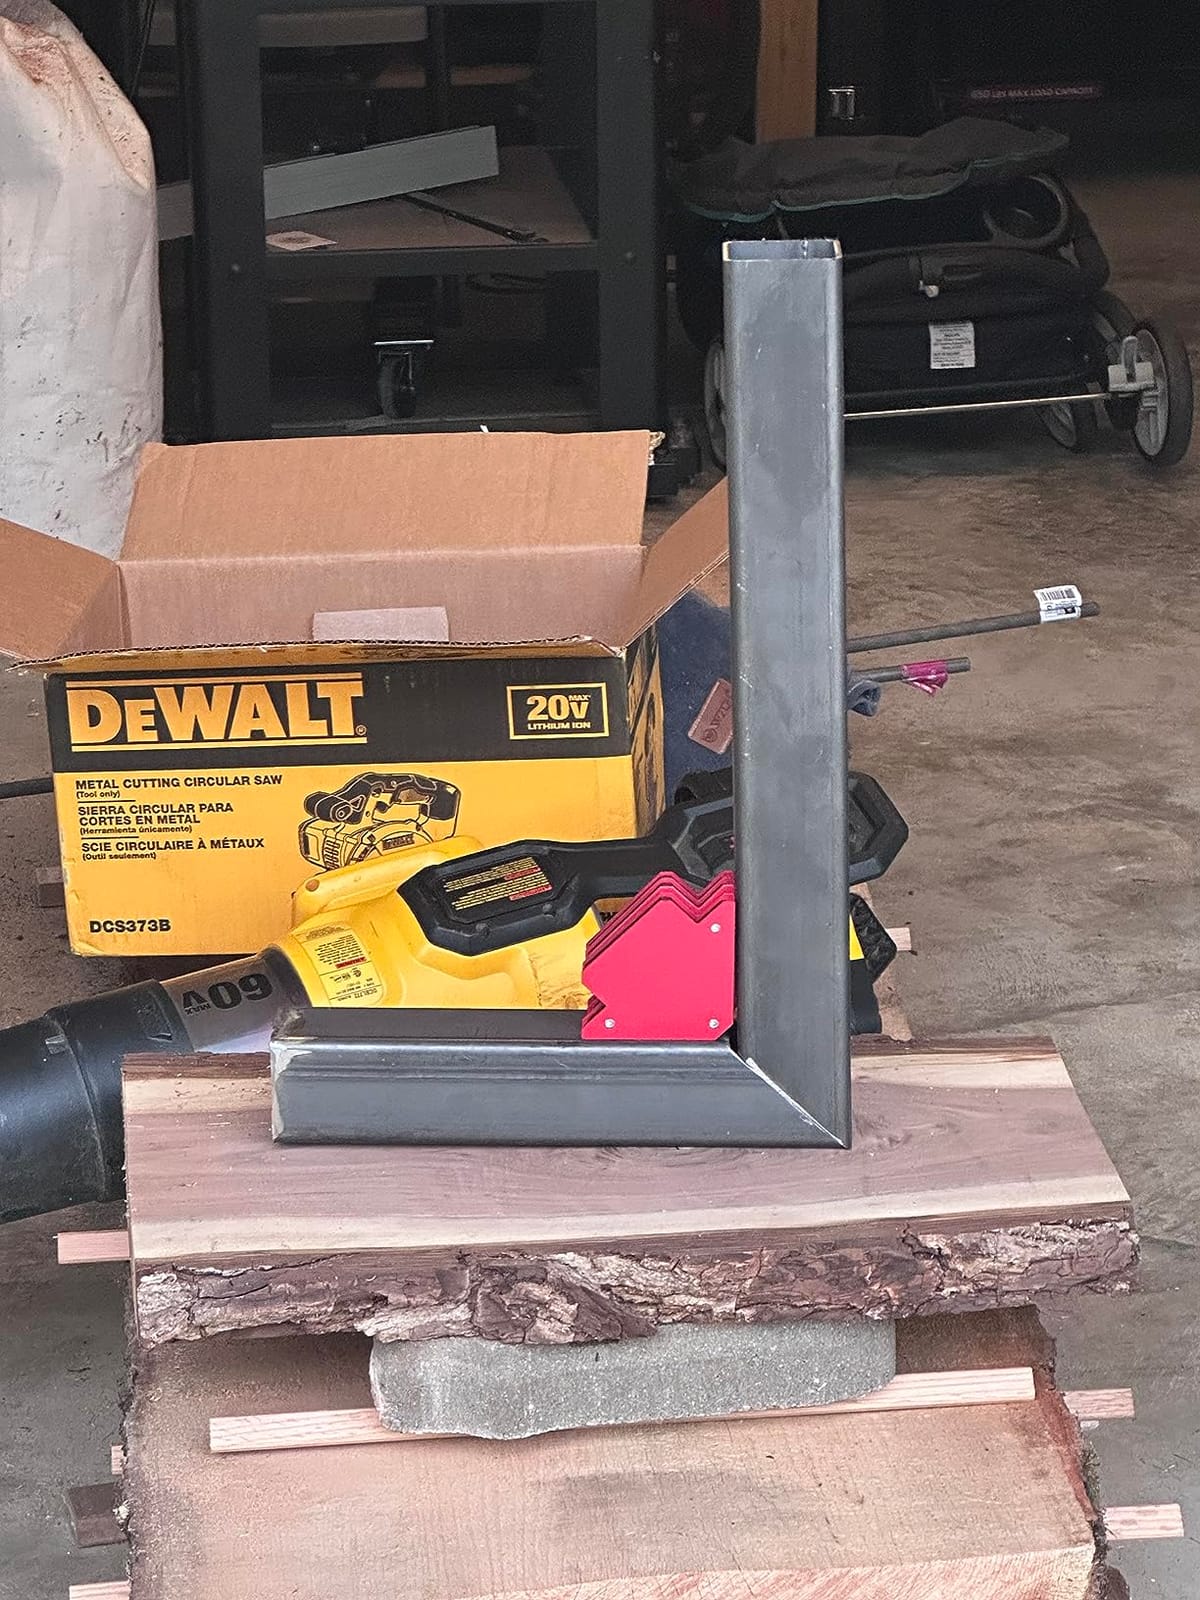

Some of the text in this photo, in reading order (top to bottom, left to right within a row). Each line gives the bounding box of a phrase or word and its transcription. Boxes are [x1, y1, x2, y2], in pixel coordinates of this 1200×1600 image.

[66, 681, 364, 744] DEWALT
[527, 721, 591, 730] LITHIUM ION
[75, 774, 282, 790] METAL CUTTING CIRCULAR SAW
[76, 790, 120, 799] (Tool only)
[78, 802, 234, 815] SIERRA CIRCULAR PARA
[79, 814, 200, 826] CORTES EN METAL
[80, 827, 136, 835] (Herramienta
[81, 837, 264, 852] SCIE CIRCULAIRE À MÉTAUX
[82, 852, 156, 861] (Outil seulement)
[89, 919, 171, 933] DCS373B
